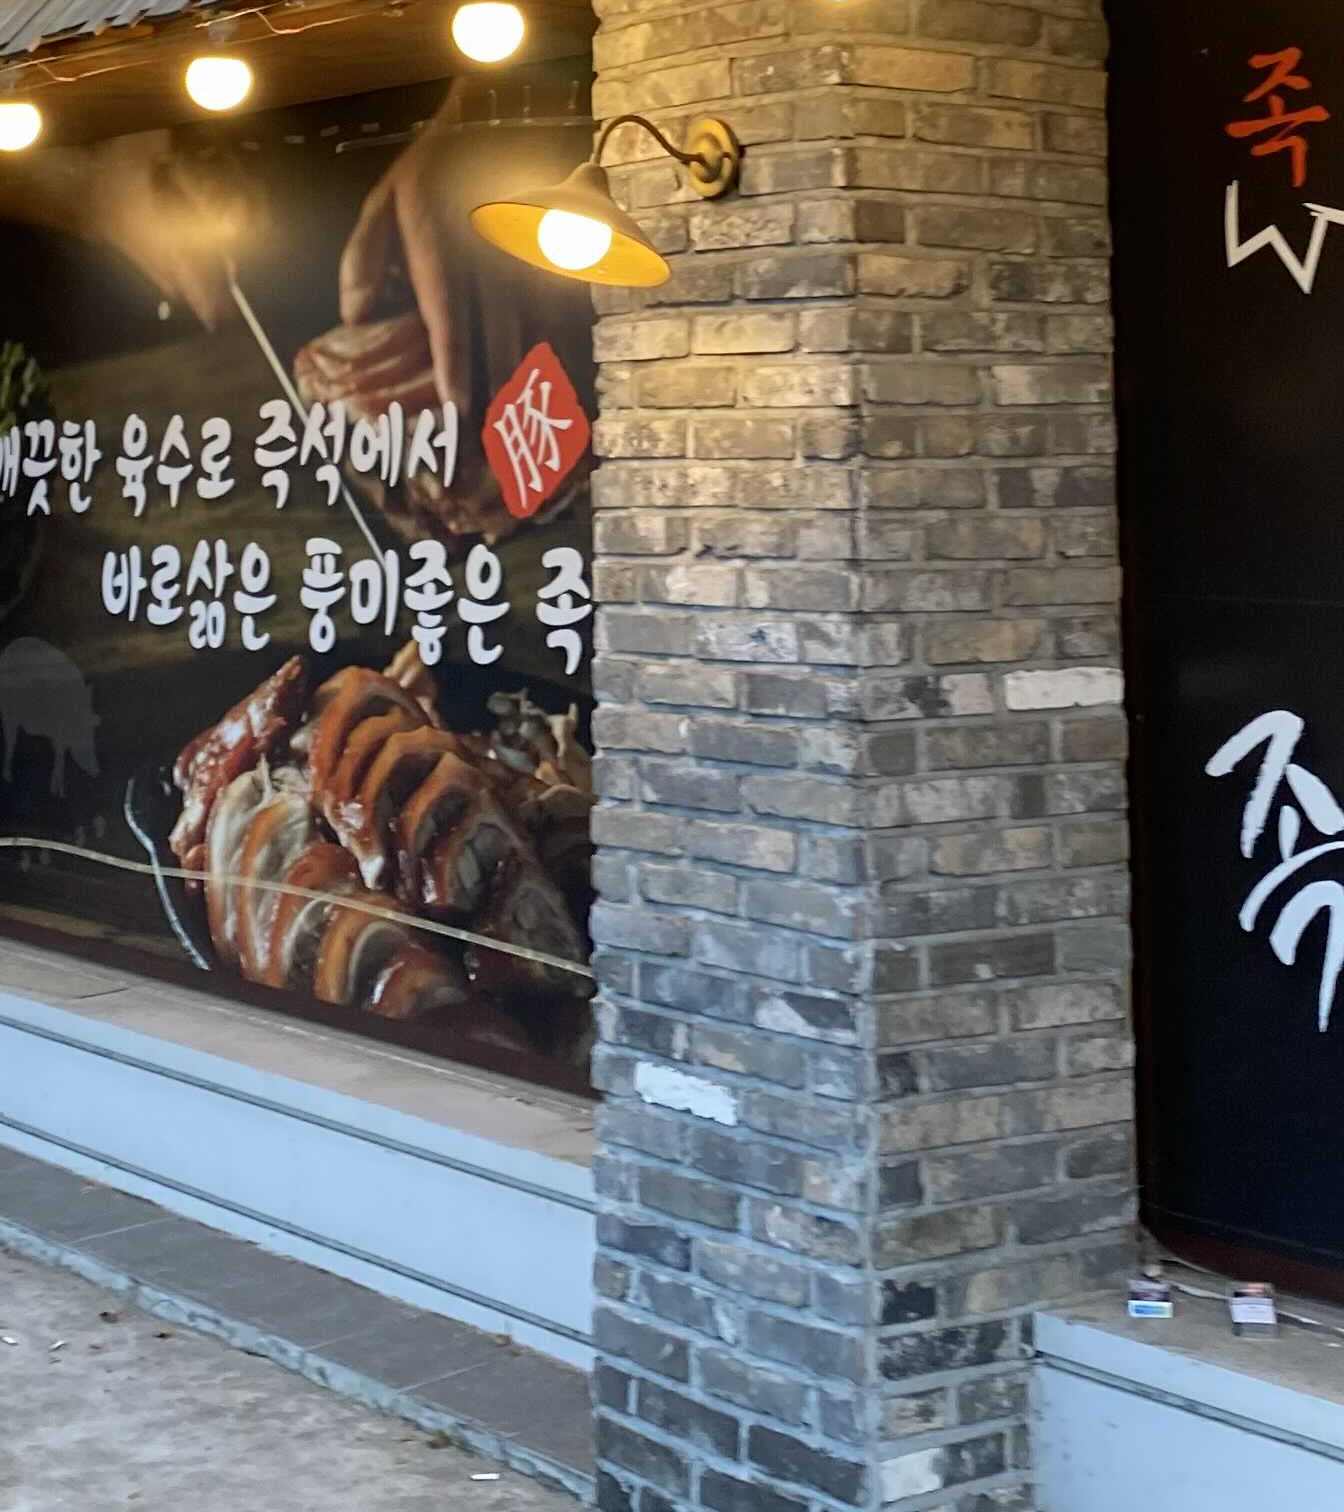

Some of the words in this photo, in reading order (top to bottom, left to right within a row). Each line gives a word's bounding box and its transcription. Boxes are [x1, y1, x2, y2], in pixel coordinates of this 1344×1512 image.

[115, 414, 235, 517] 육수로
[254, 398, 460, 510] 즉석에서
[101, 538, 276, 652] 바로삶은
[299, 537, 511, 667] 풍미좋은
